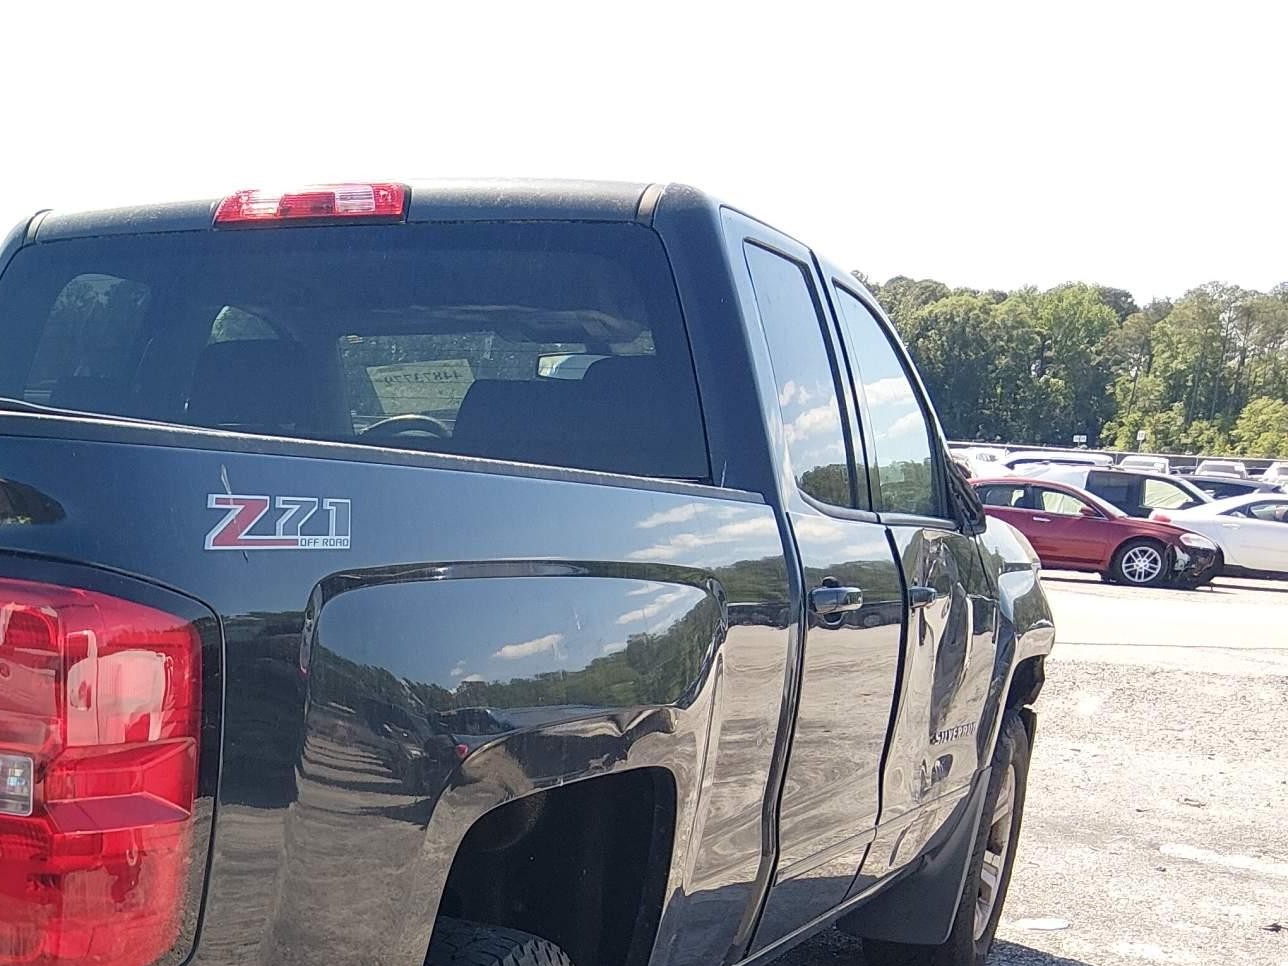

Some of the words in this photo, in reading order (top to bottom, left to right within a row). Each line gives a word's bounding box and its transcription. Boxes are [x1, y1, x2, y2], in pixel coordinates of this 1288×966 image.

[205, 494, 351, 550] Z71
[300, 538, 321, 547] OFF
[322, 538, 349, 547] ROAD
